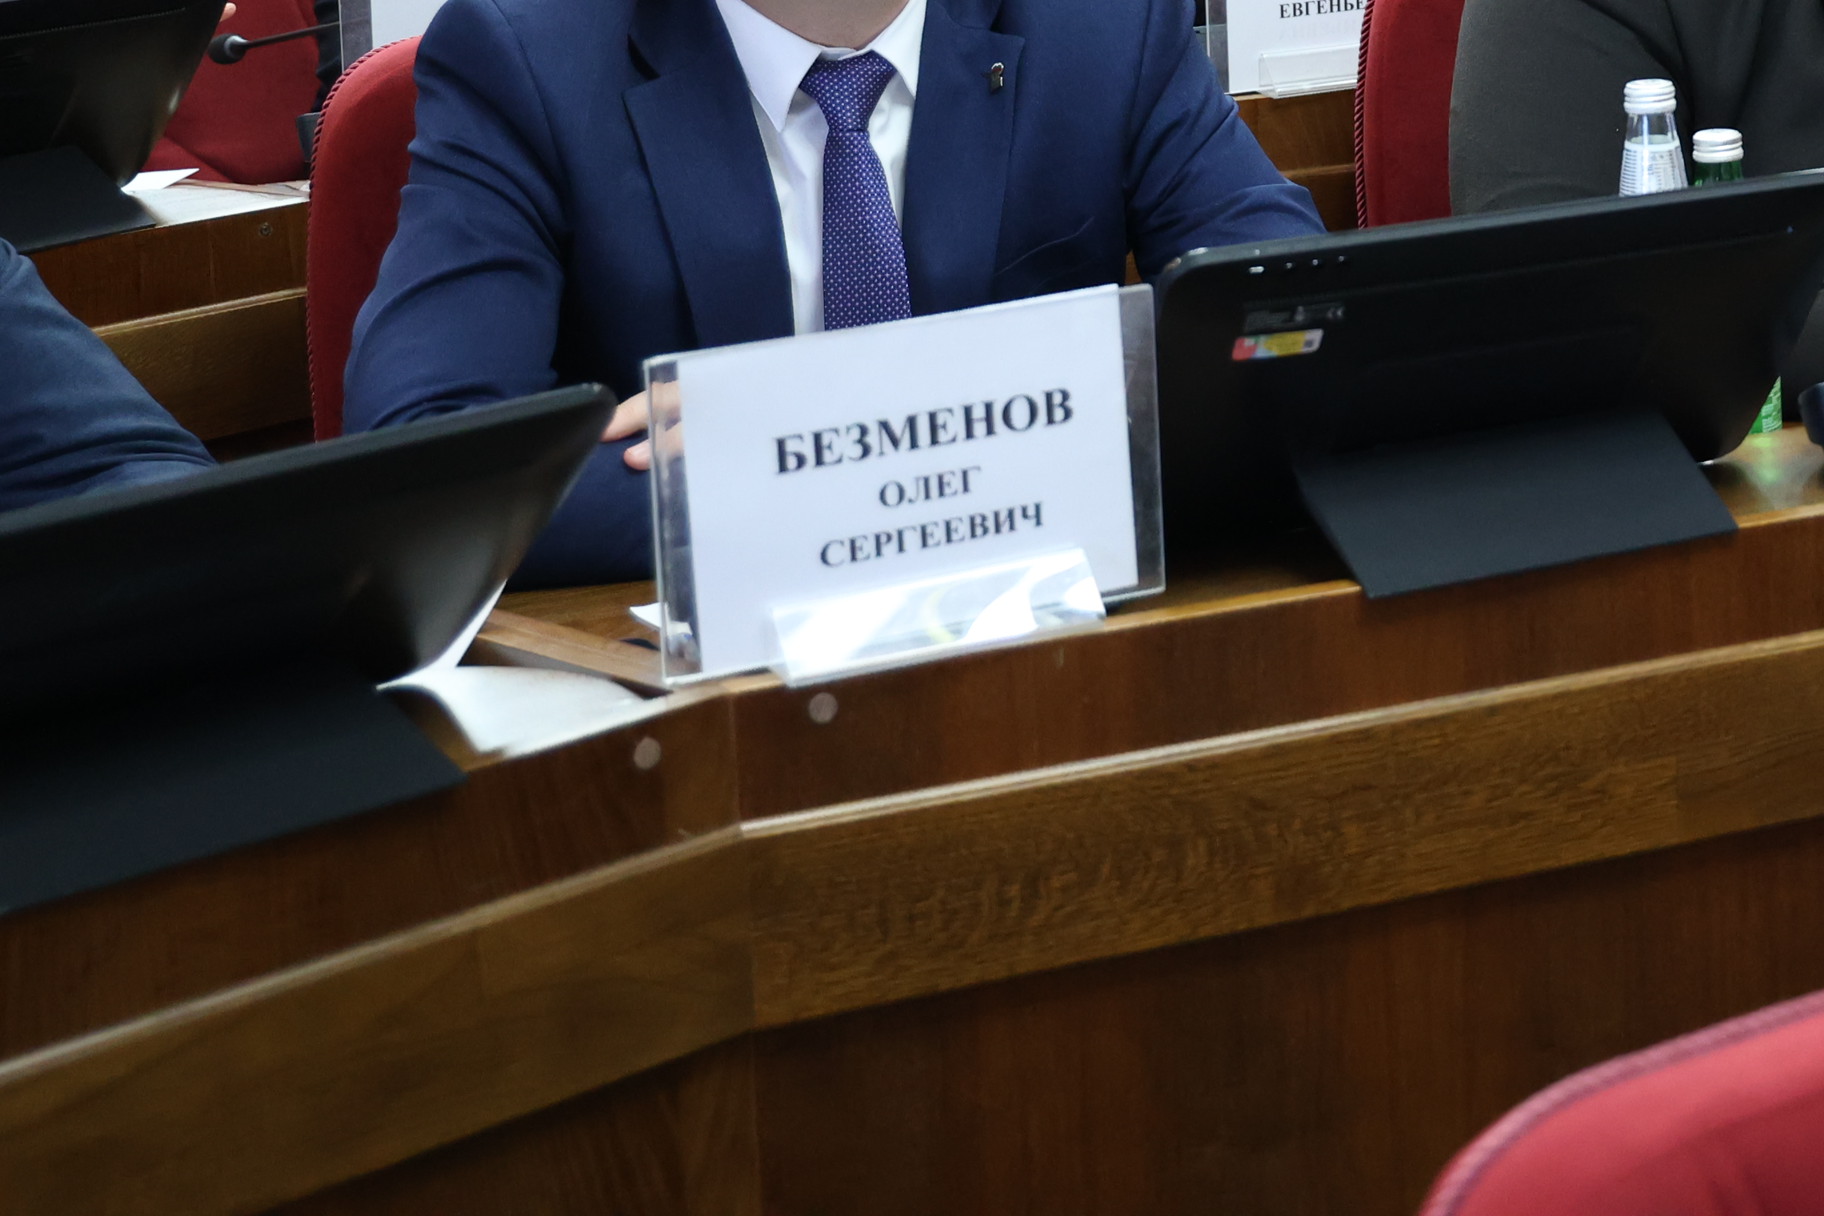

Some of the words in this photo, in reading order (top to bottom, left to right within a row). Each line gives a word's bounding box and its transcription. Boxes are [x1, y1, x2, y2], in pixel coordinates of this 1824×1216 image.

[774, 387, 1075, 476] БЕЗМЕНОВ
[878, 465, 982, 510] ОЛЕГ
[819, 501, 1045, 569] СЕРГЕЕВИЧ
